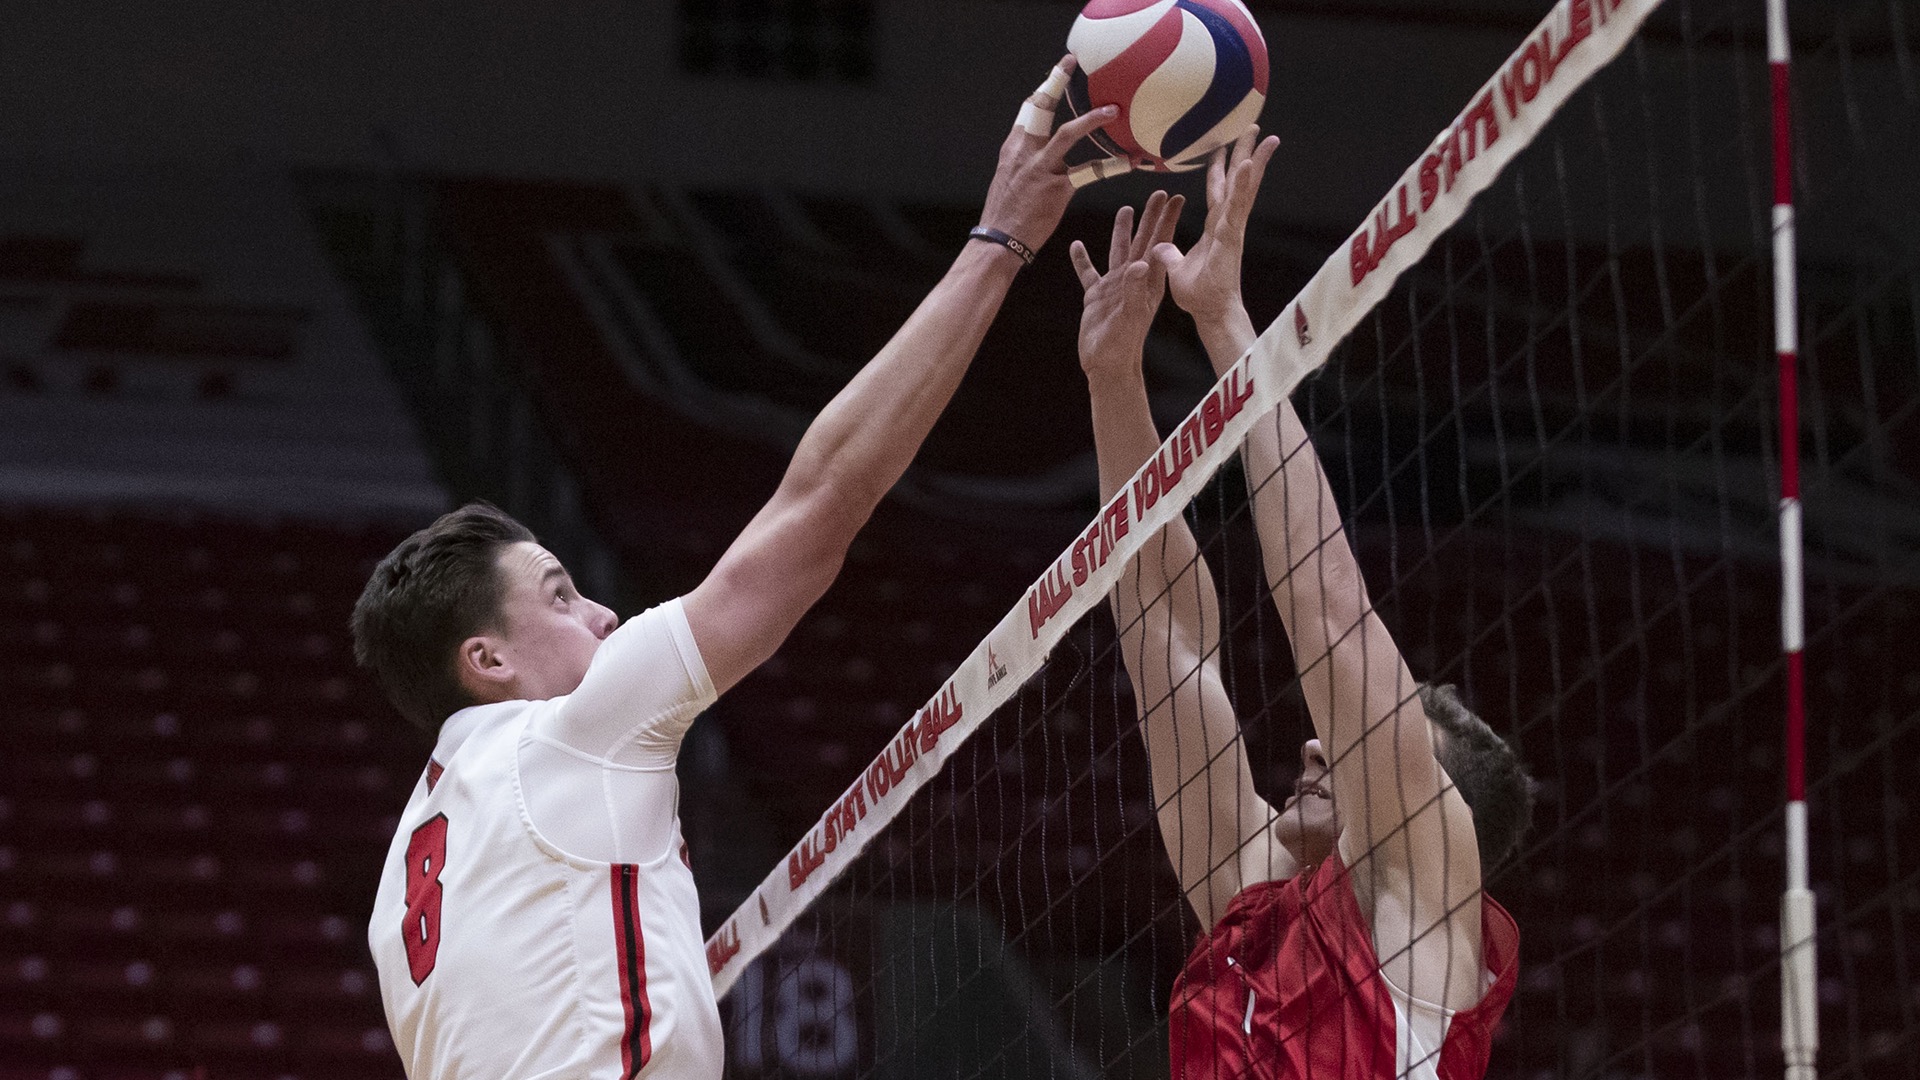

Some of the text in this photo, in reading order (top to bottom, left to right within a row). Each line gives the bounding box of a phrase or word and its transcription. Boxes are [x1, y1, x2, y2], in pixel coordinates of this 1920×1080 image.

[1071, 489, 1129, 588] STATE
[825, 781, 867, 844] STATE
[866, 681, 963, 806] VOLLEYBALL
[401, 811, 449, 988] 8
